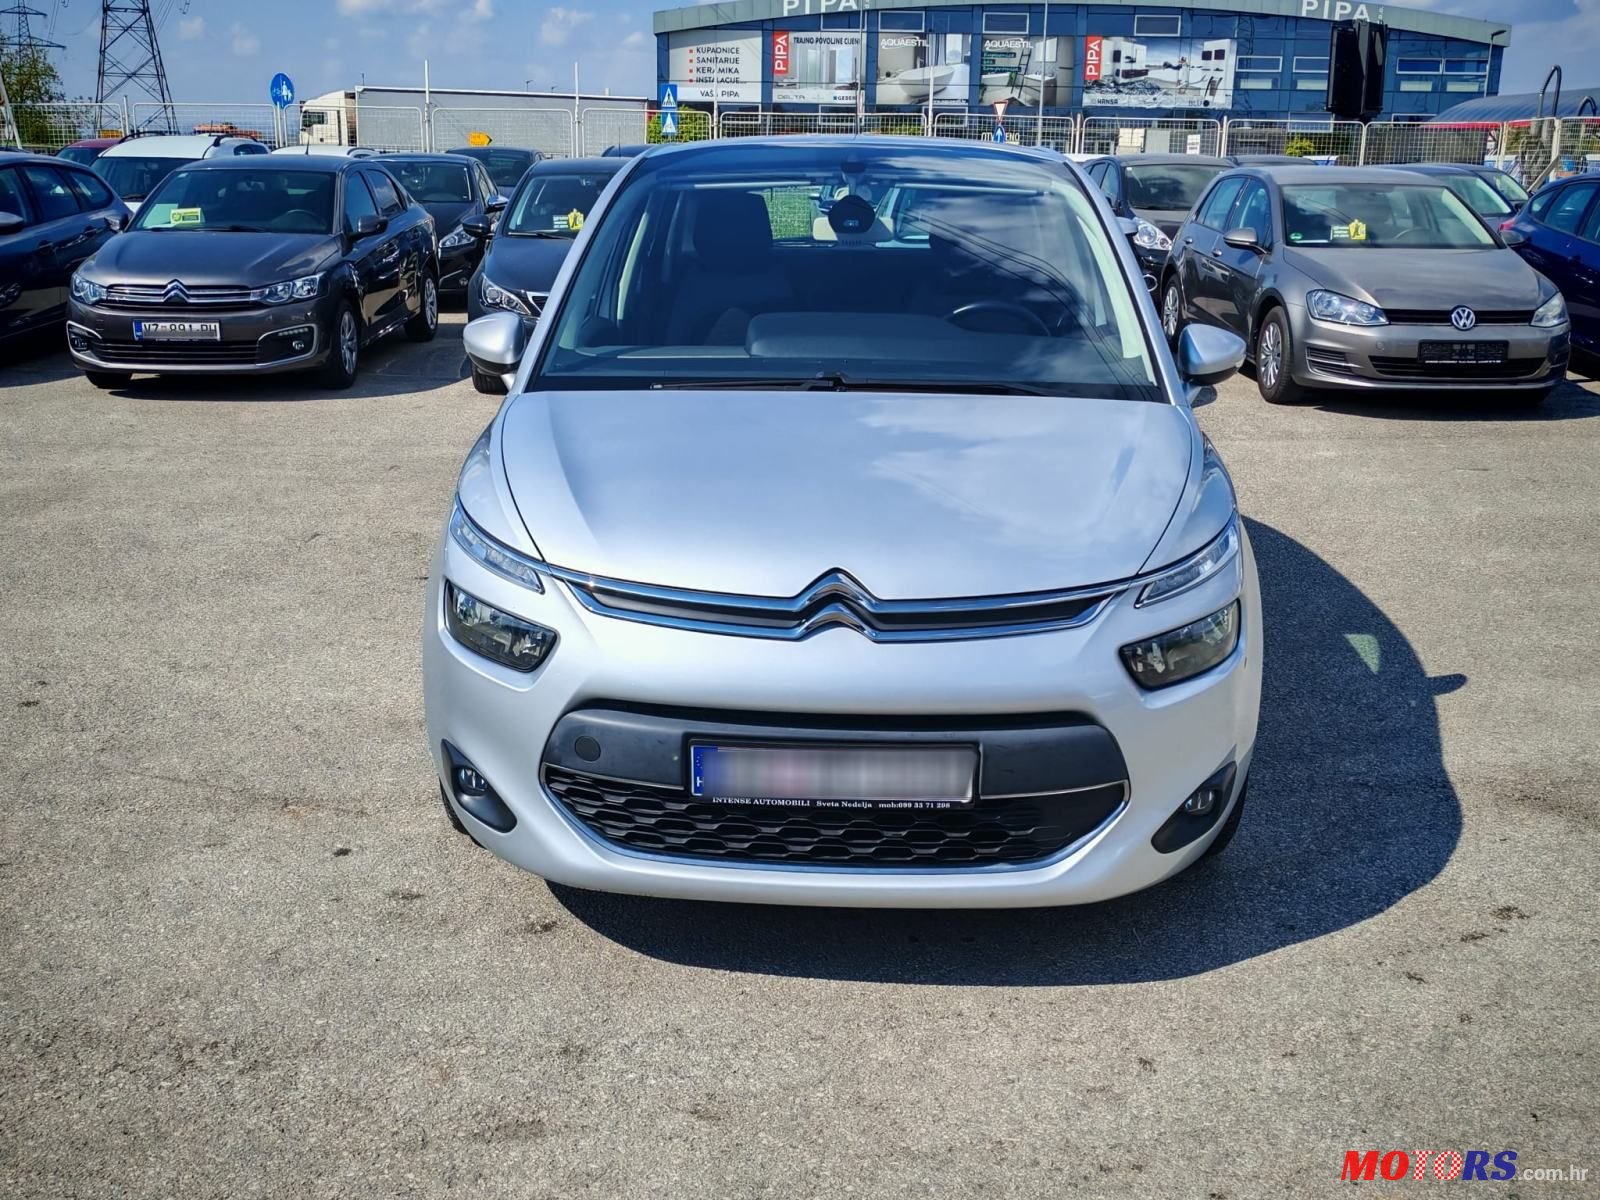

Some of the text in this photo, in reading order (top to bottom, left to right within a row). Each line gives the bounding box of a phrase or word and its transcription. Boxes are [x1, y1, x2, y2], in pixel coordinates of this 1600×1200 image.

[783, 0, 858, 17] PIPA
[1301, 0, 1370, 23] PIPA
[793, 37, 814, 45] TRAJNO
[815, 37, 843, 45] POVOLJNE
[880, 37, 930, 49] AQUAESTIL
[984, 38, 1034, 50] AQUAESTIL
[775, 34, 788, 71] PIPA
[1086, 39, 1101, 76] PIPA
[696, 56, 740, 64] SANITARIJE
[700, 88, 740, 98] VAŠ PIPA
[712, 796, 752, 804] INTENSE
[753, 798, 811, 807] AUTOMOBILI
[816, 800, 840, 808] Sveta
[841, 800, 873, 809] Nedelja
